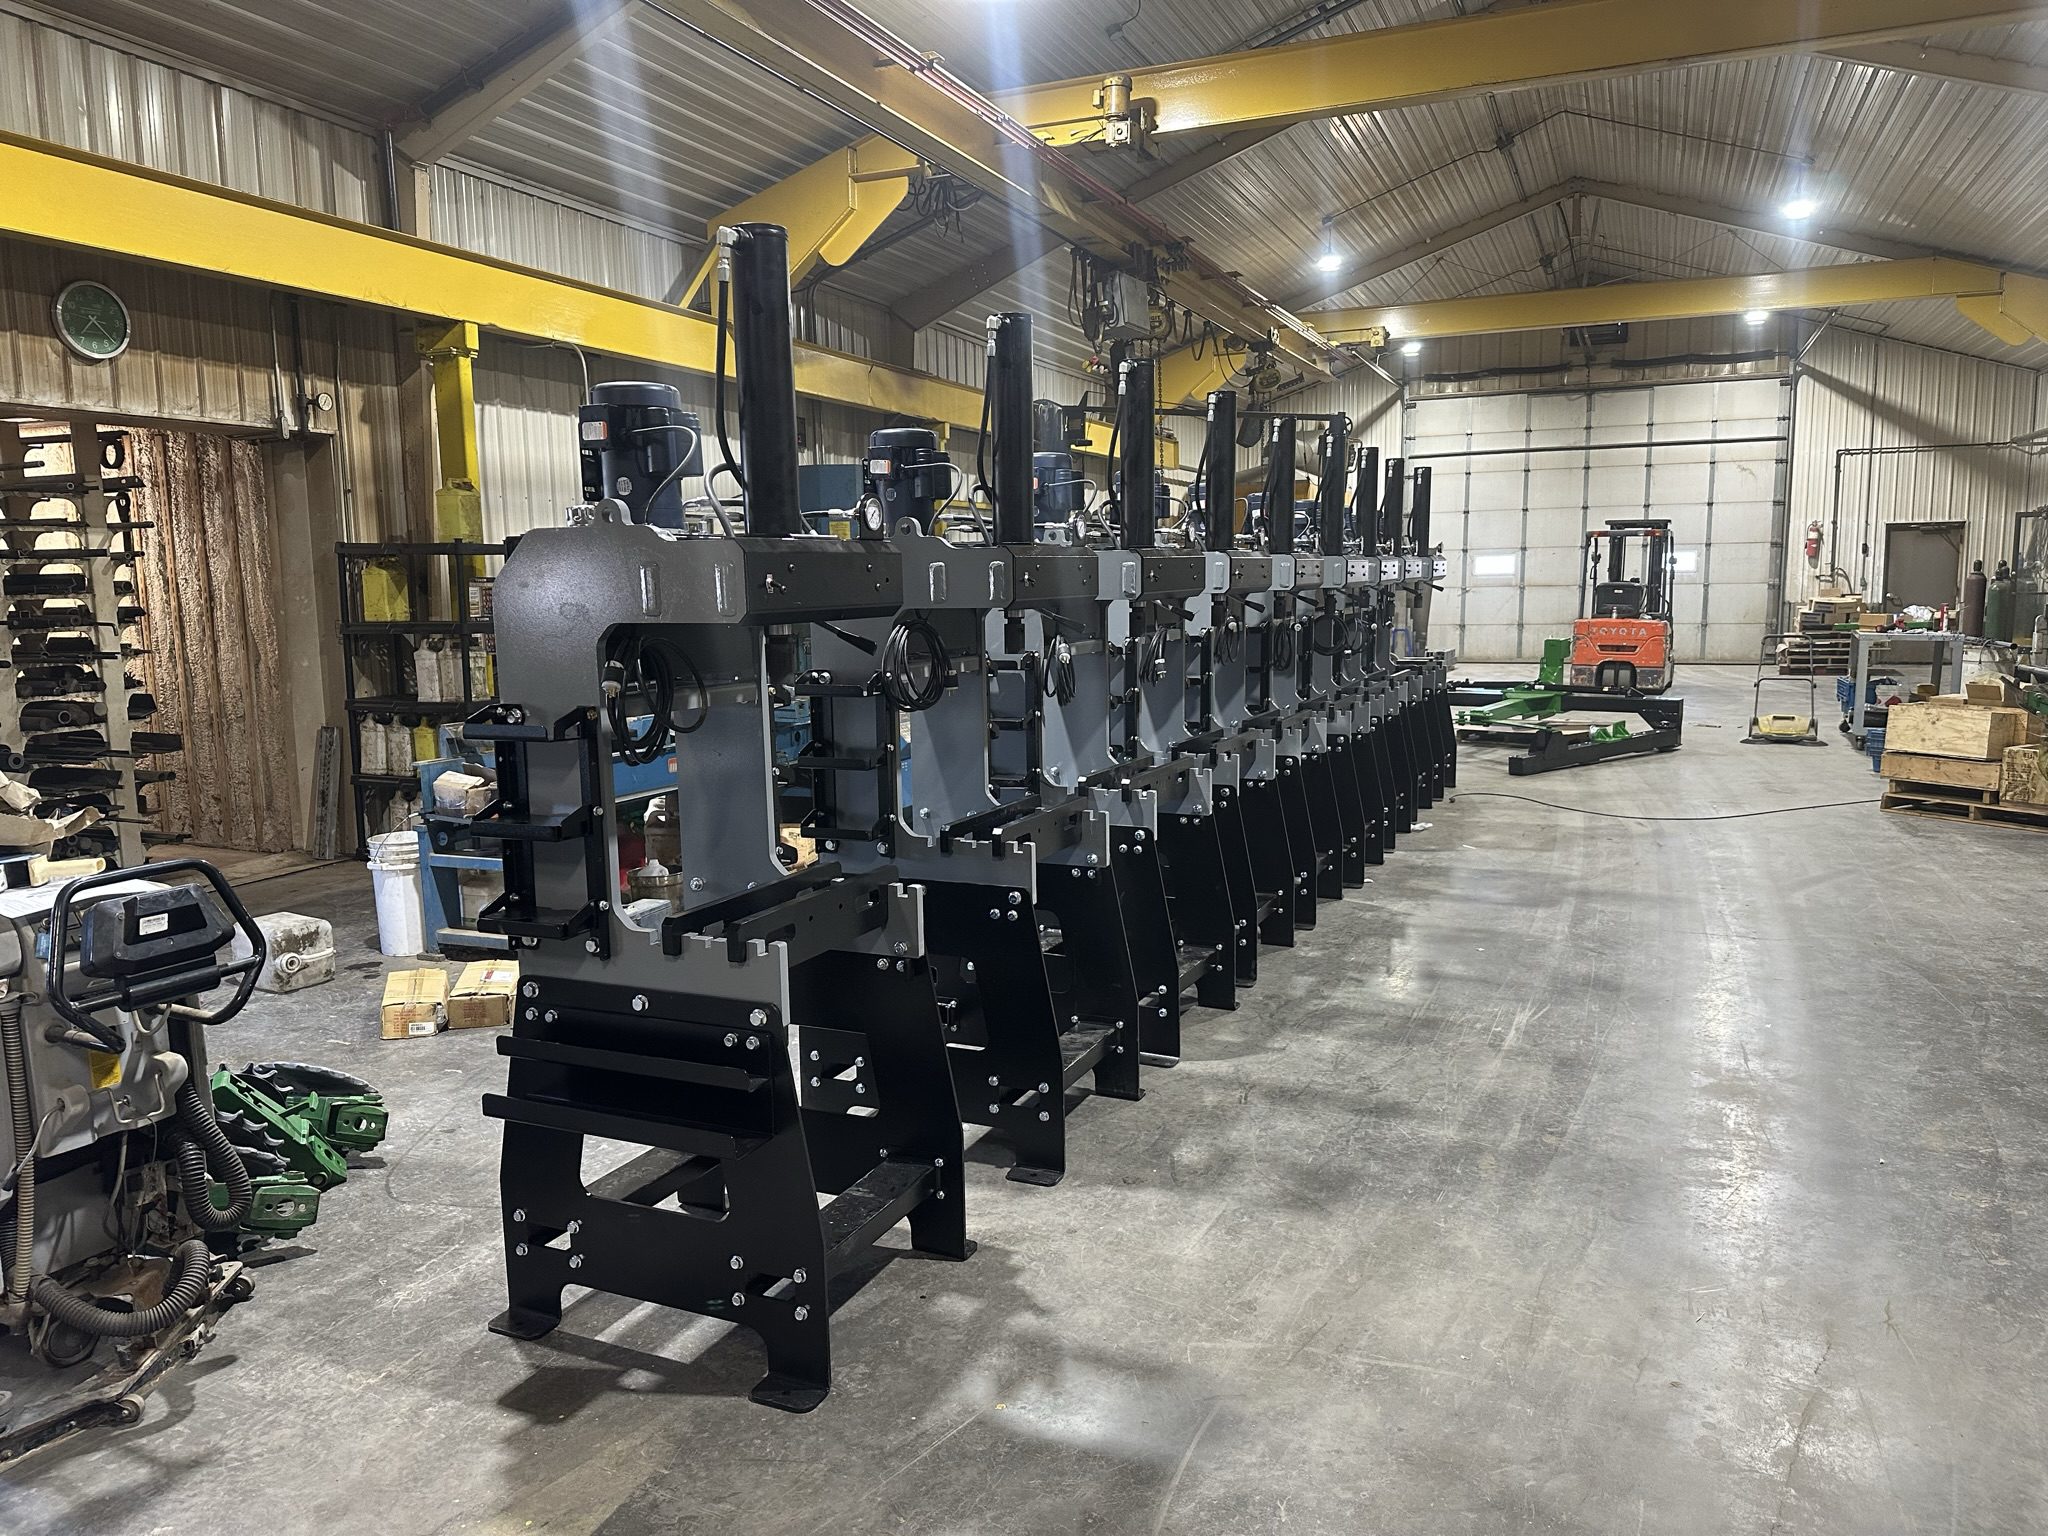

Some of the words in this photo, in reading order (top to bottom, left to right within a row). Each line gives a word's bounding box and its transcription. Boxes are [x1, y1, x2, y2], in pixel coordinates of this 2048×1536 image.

[80, 336, 85, 345] 7
[92, 341, 98, 349] 6
[1590, 626, 1647, 636] TOYOTA
